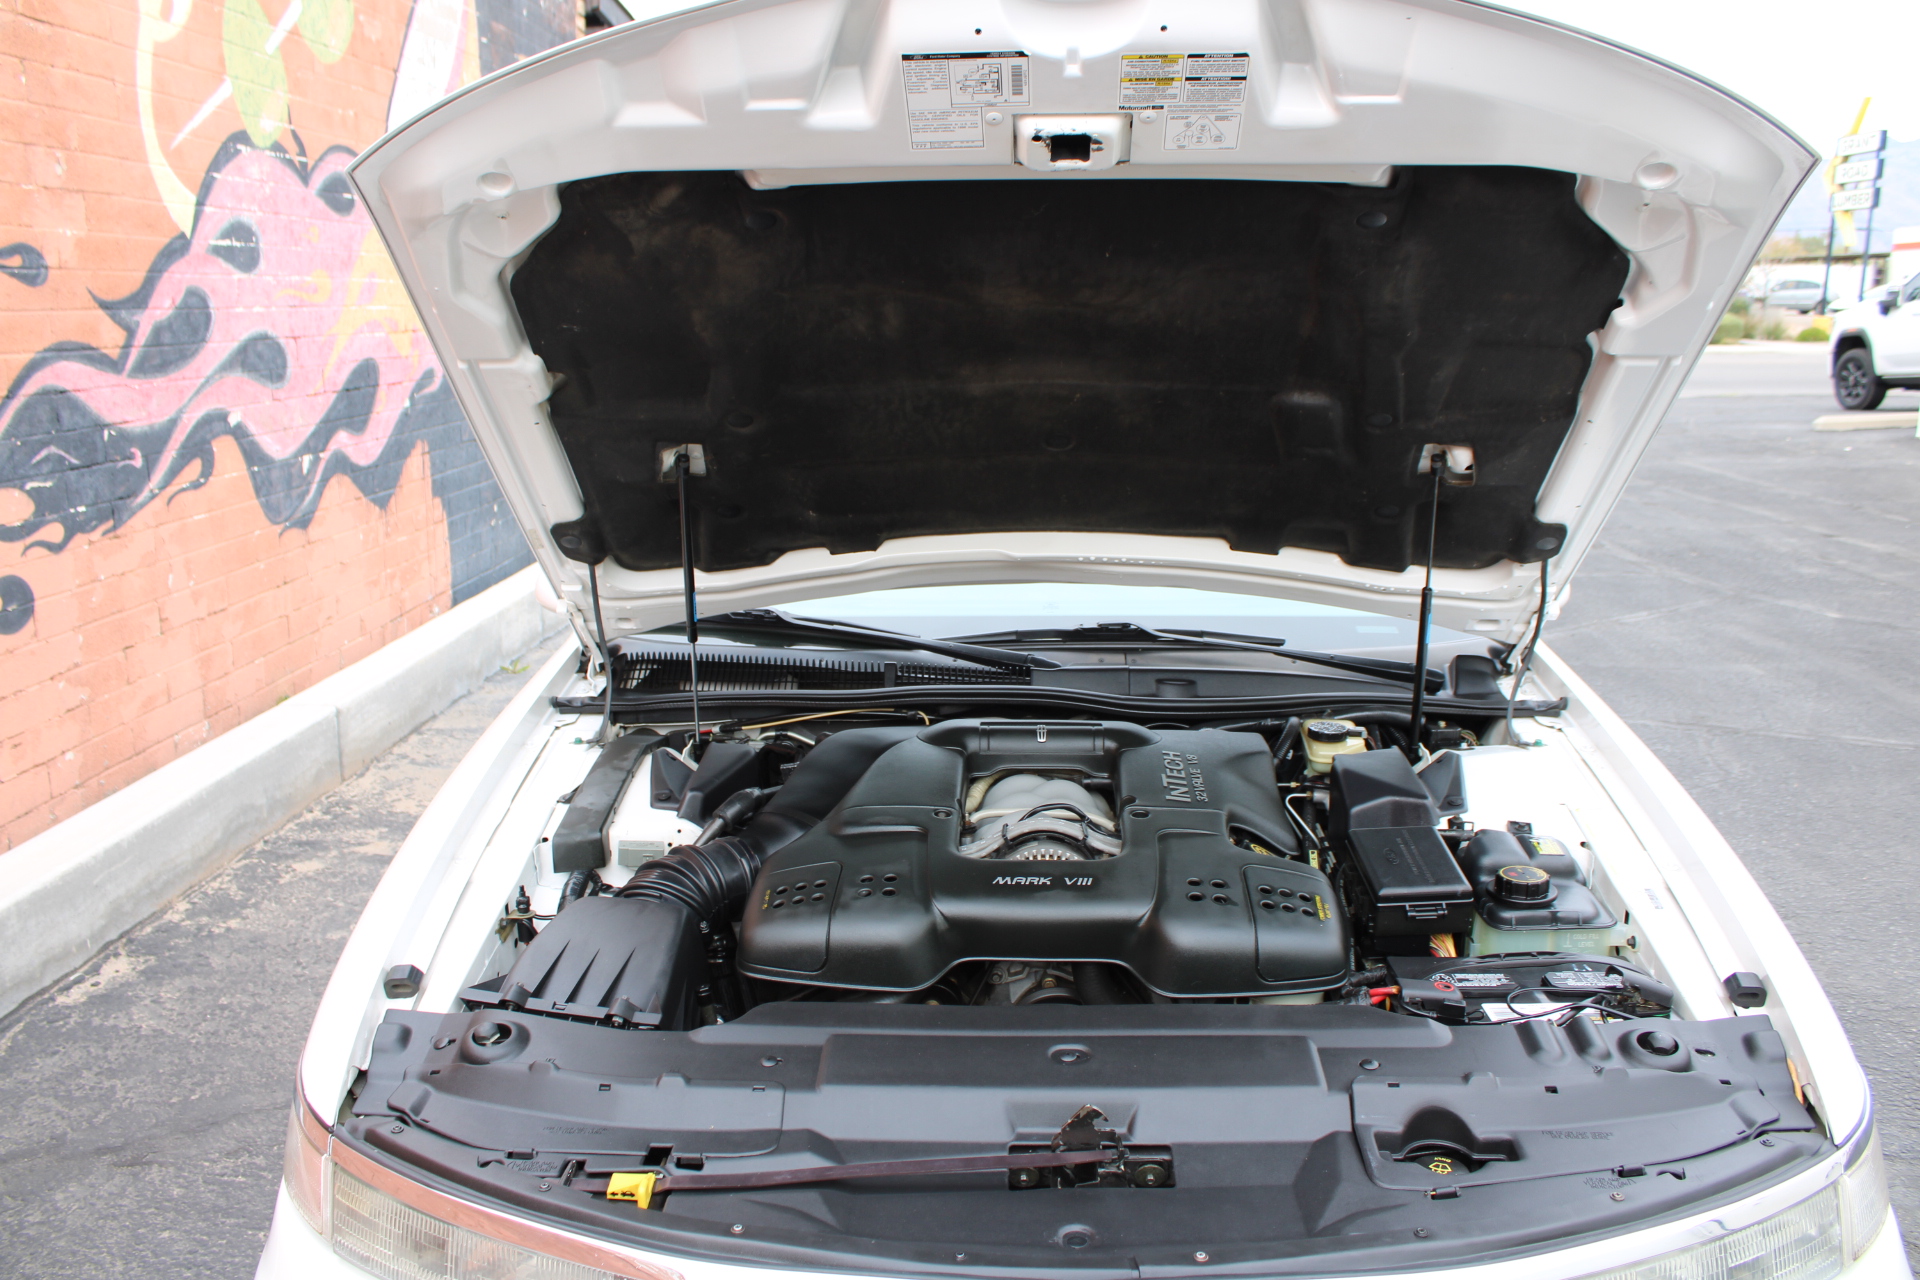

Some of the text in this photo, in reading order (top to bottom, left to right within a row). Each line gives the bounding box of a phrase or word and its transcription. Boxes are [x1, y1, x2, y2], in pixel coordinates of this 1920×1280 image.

[1842, 134, 1876, 152] GRANT
[1842, 164, 1869, 179] ROAD
[1833, 192, 1870, 208] LUMBER
[1186, 754, 1199, 765] V8
[992, 876, 1093, 886] MARK VIII
